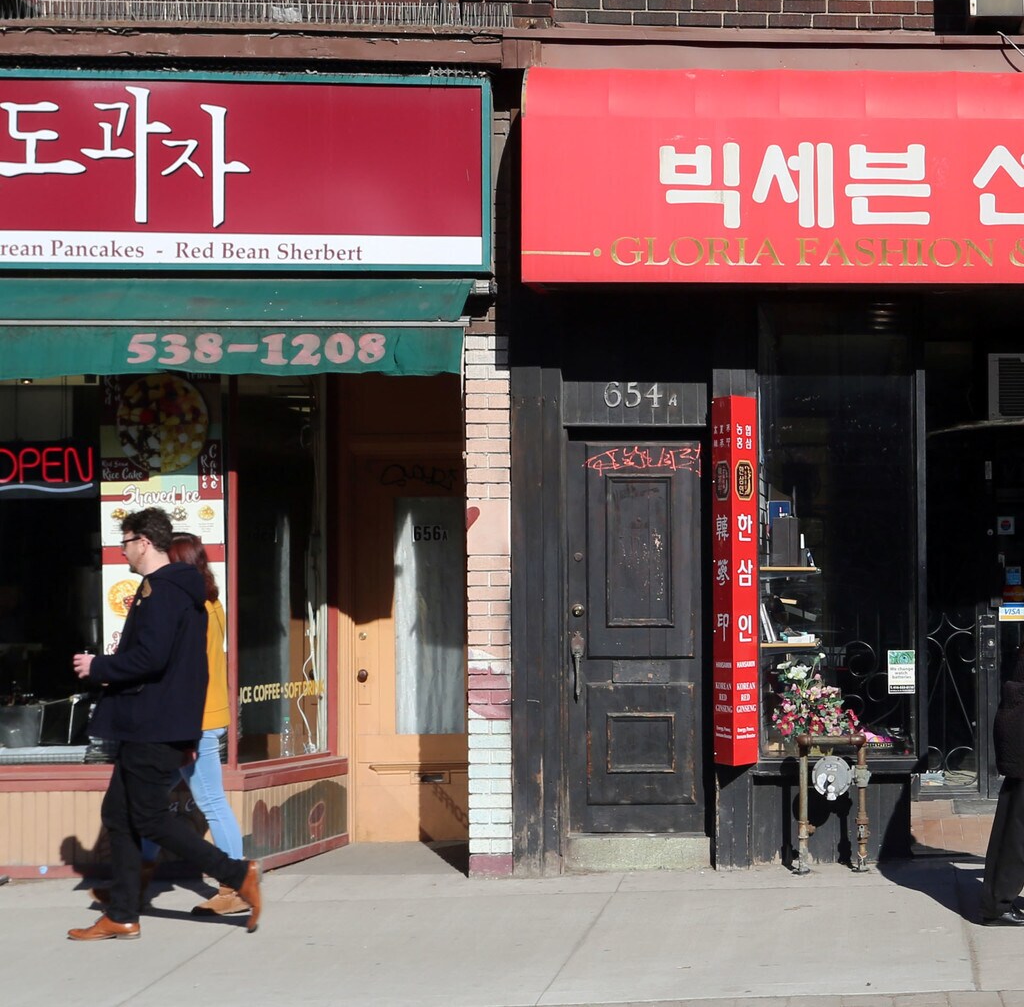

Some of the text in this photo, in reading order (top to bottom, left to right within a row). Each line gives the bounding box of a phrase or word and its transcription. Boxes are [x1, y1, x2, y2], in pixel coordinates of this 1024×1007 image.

[658, 141, 932, 229] 빅세븐
[51, 240, 145, 259] Pancakes
[175, 241, 215, 259] Red
[222, 241, 270, 260] Bean
[277, 242, 363, 261] Sherbert
[610, 236, 785, 267] GLORIA
[796, 237, 996, 268] FASHION
[126, 333, 386, 367] 538-1208
[102, 468, 144, 481] Rice Cake
[122, 484, 201, 507] Shaved Ice
[737, 513, 754, 643] 한삼인
[239, 686, 252, 704] ICE
[253, 683, 281, 702] COFFEE
[284, 681, 302, 699] SOFT
[736, 682, 756, 691] KOREAN
[740, 694, 751, 702] RED
[736, 704, 757, 713] GINSENG
